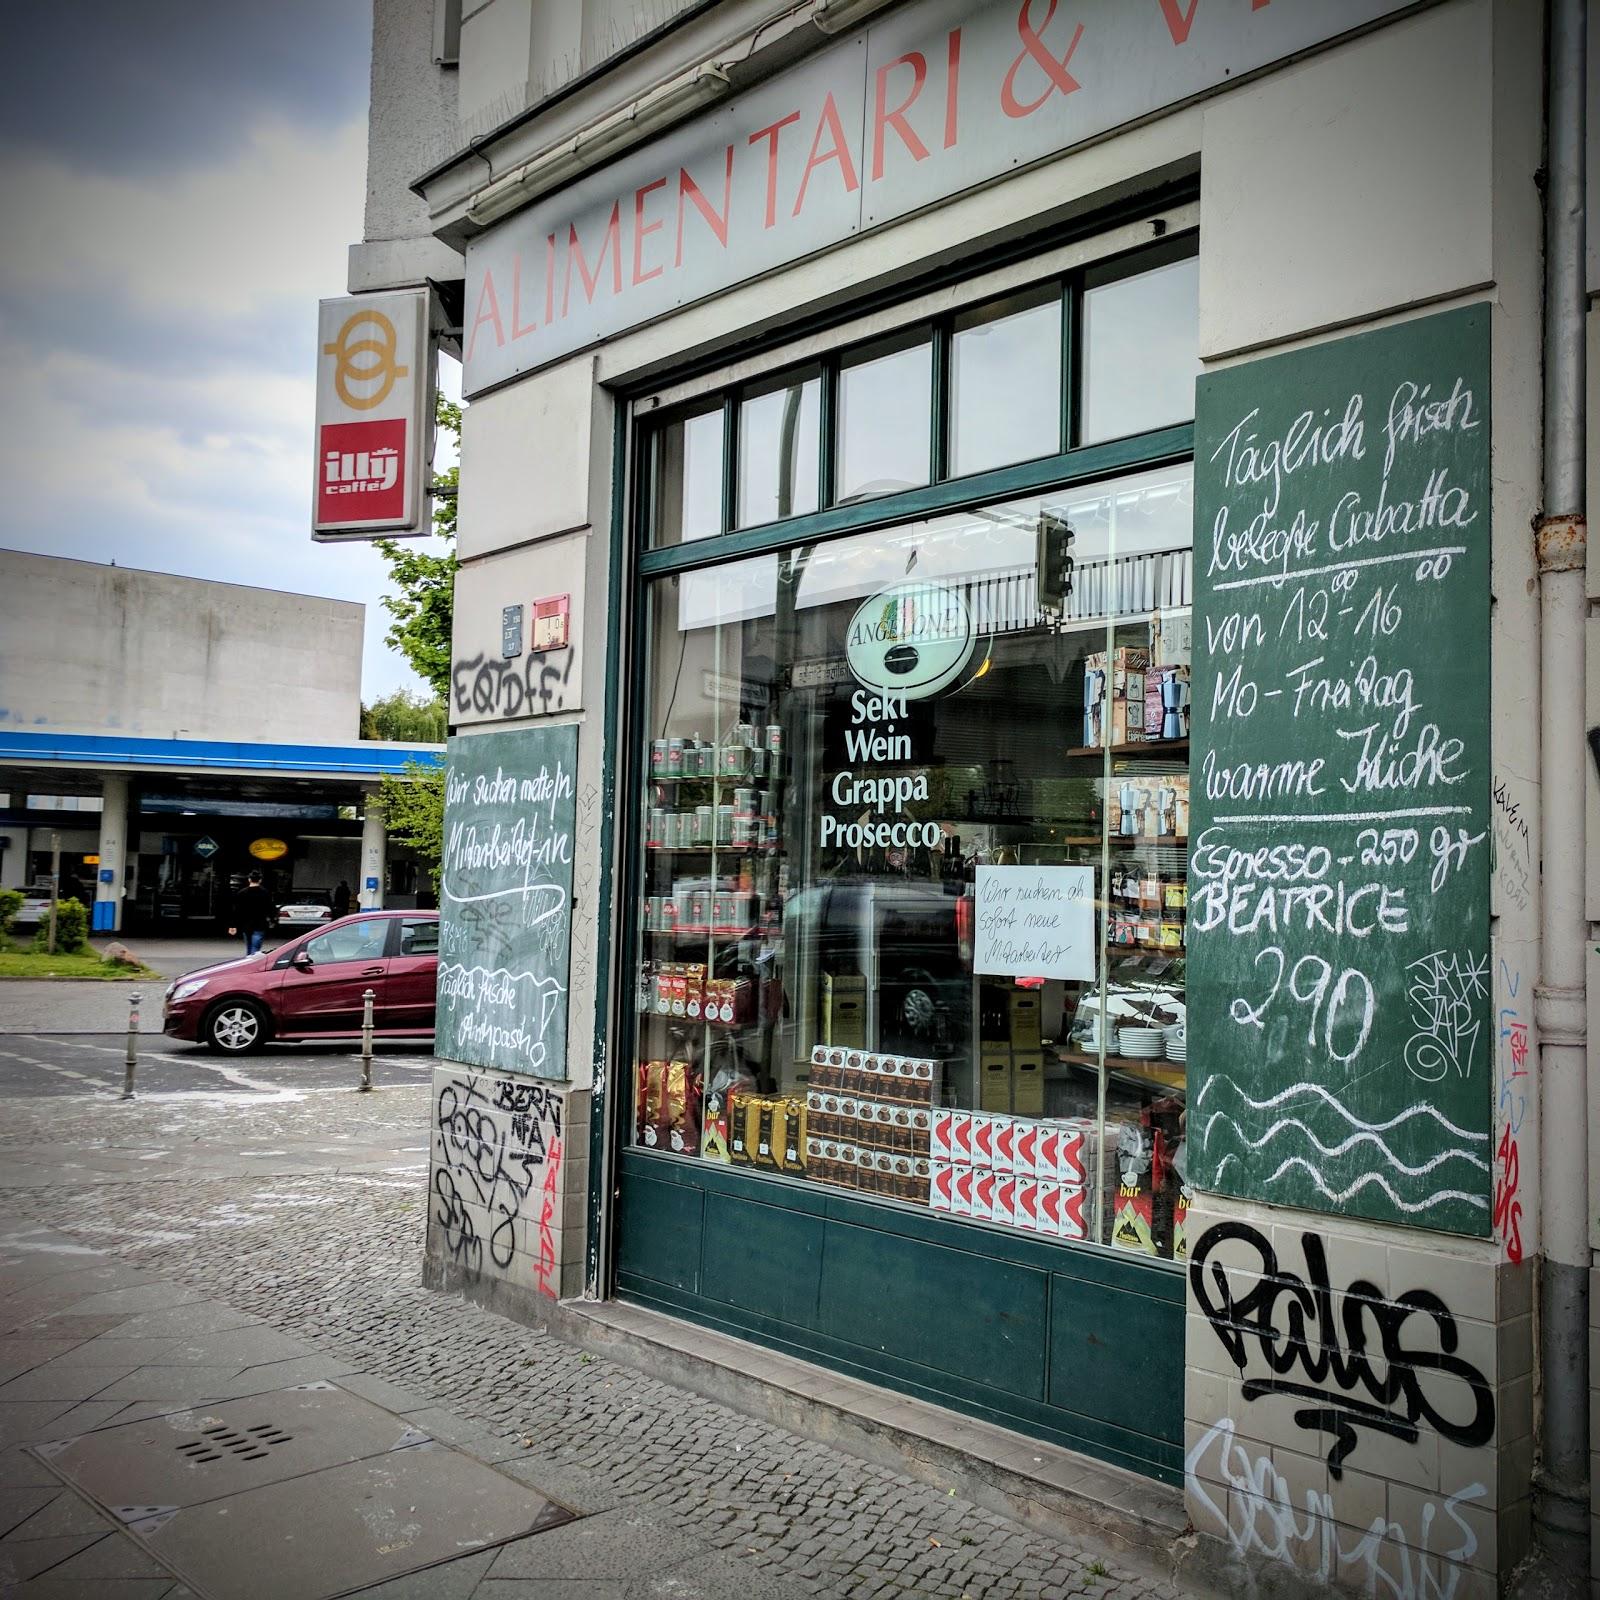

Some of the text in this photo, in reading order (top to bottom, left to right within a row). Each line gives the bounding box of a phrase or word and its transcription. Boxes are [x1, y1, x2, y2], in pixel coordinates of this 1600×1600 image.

[466, 0, 1084, 361] ALIMENTARI &
[324, 448, 399, 491] illy
[1206, 611, 1266, 655] von
[851, 686, 909, 725] Sekt
[844, 724, 912, 763] Wein
[832, 771, 929, 814] Grappa
[820, 815, 941, 849] Prosecco
[1190, 880, 1409, 938] BEATRICE
[1229, 946, 1376, 1062] 290
[1119, 1182, 1141, 1198] bar
